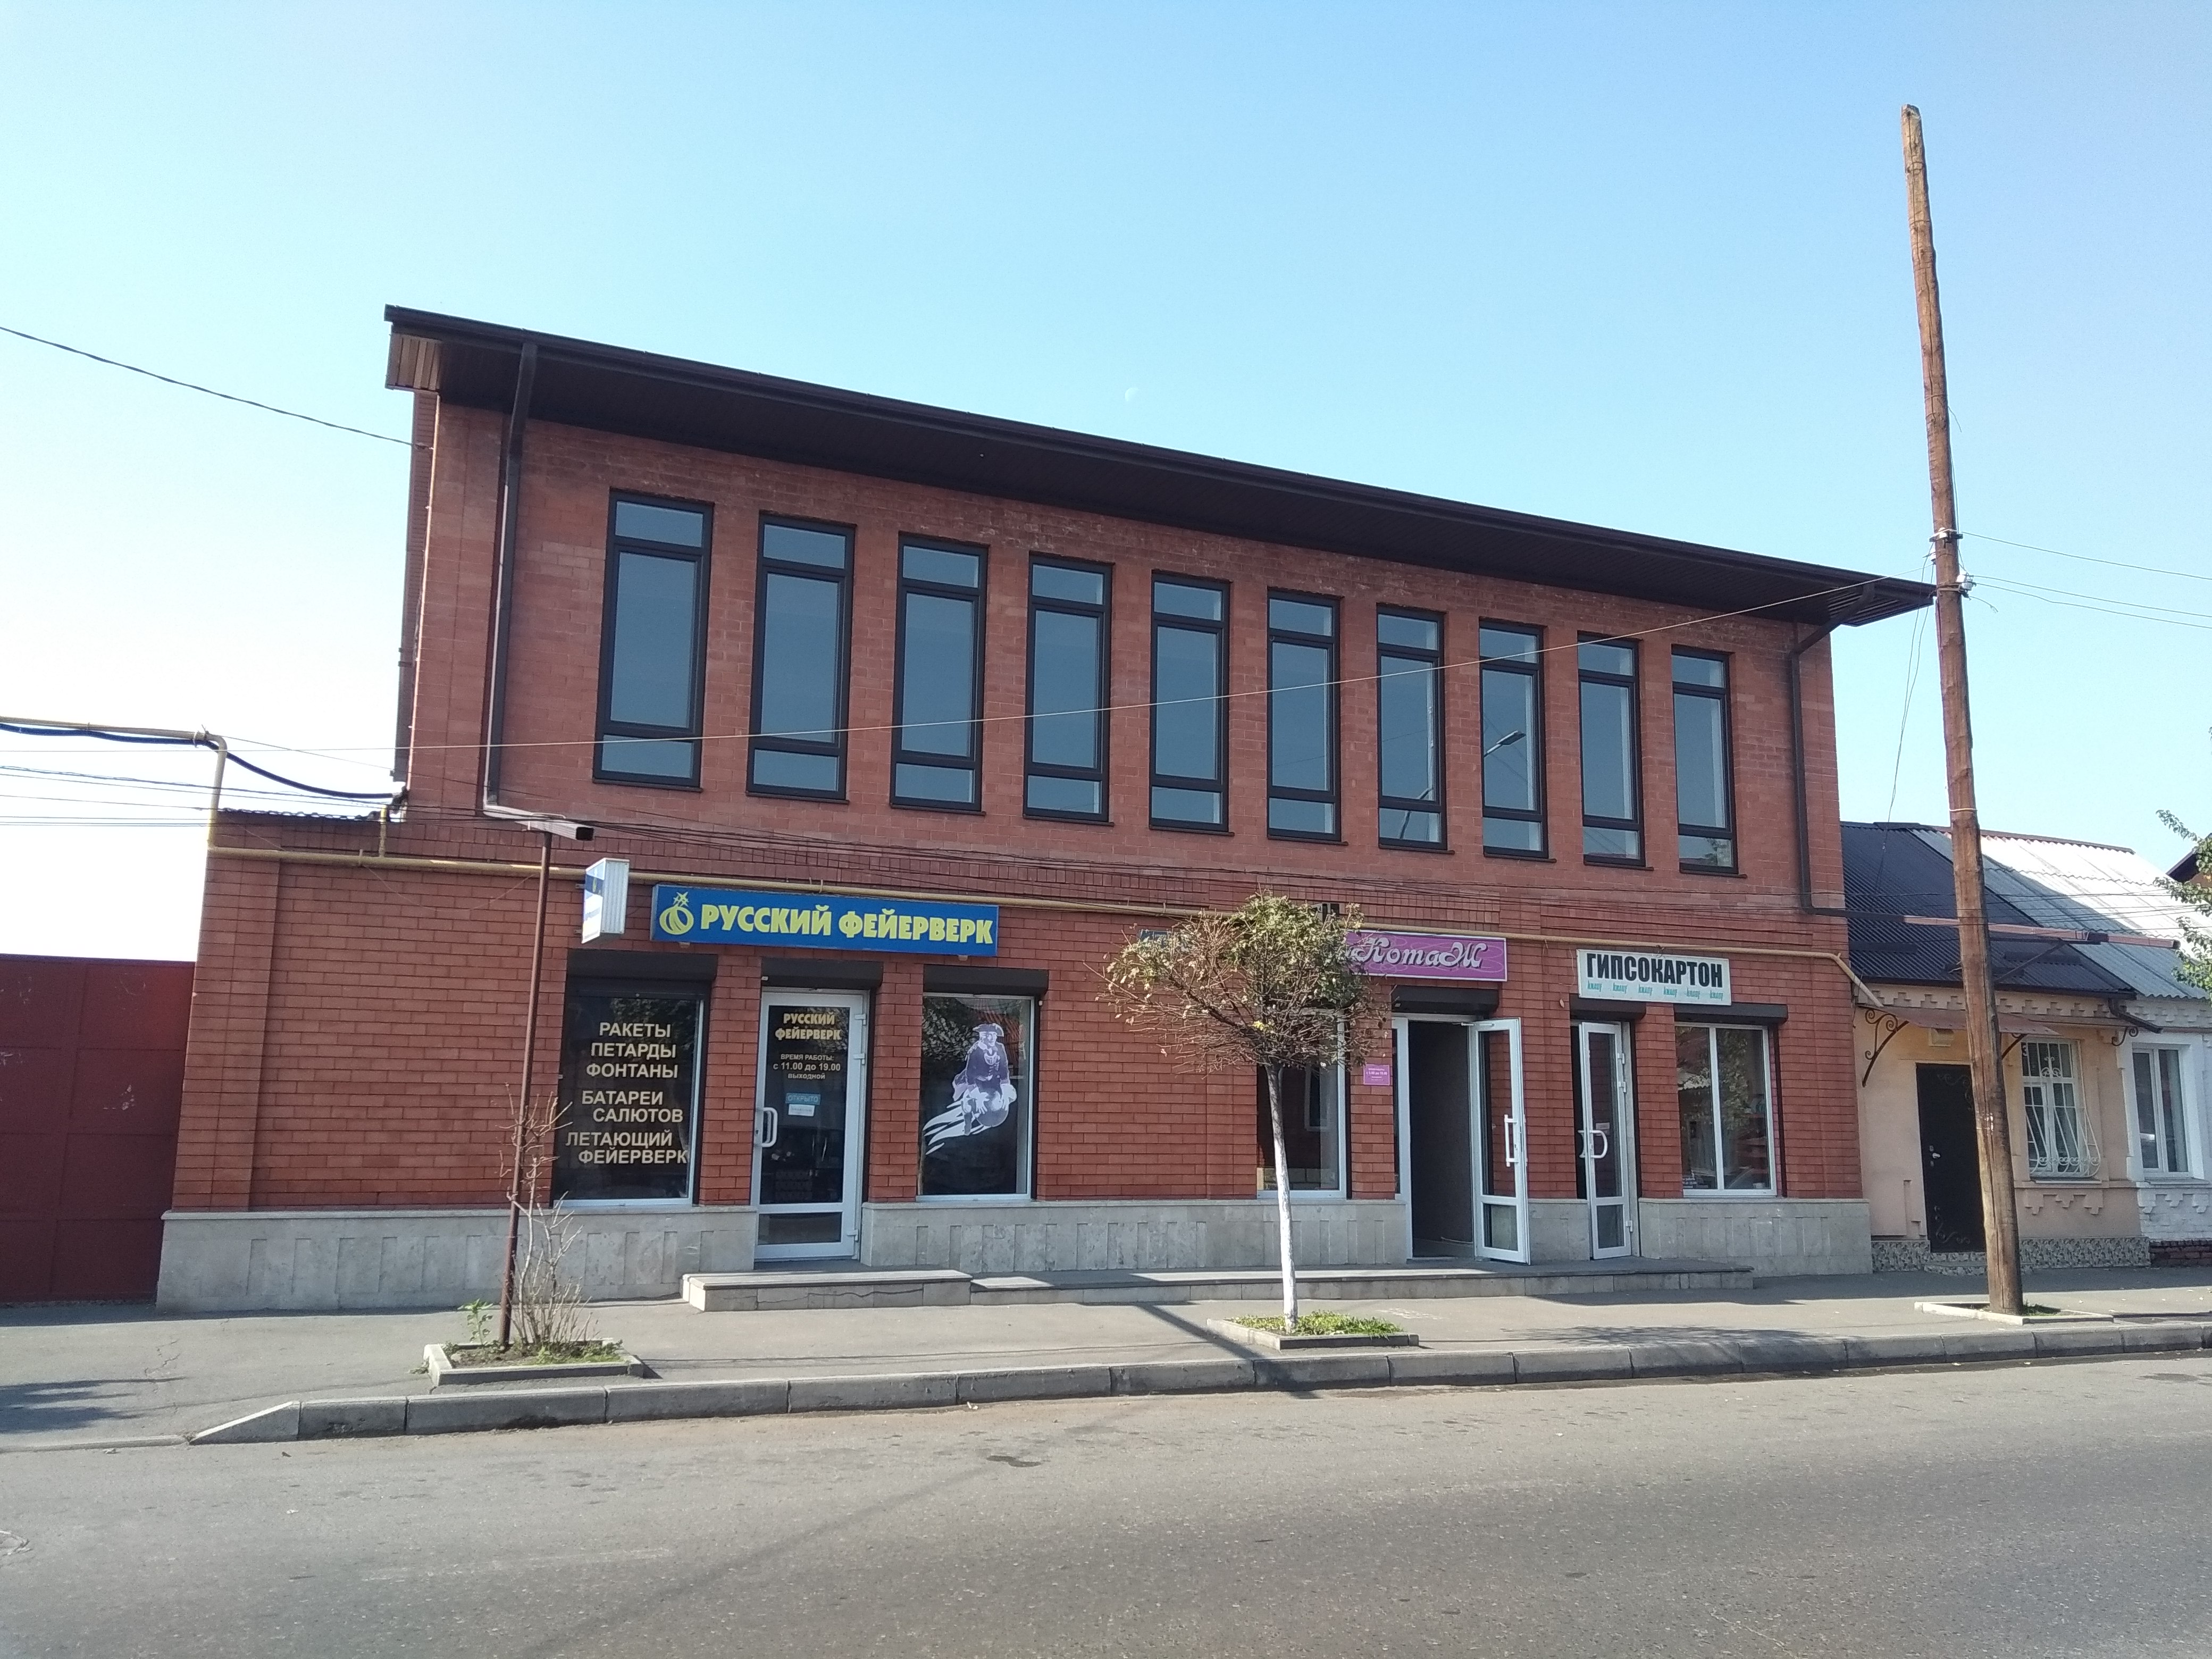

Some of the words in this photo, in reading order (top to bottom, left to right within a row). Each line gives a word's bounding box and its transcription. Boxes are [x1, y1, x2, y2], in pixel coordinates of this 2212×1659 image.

[701, 904, 832, 935] РУССКИЙ
[839, 908, 993, 944] ФЕЙЕРВЕРК
[1587, 953, 1723, 988] ГИПСОКАРТОН
[783, 1012, 835, 1024] РУССКИЙ
[599, 1022, 671, 1037] РАКЕТЫ
[775, 1026, 842, 1040] ФЕЙЕРВЕРК
[591, 1042, 676, 1060] ПЕТАРДЫ
[586, 1063, 678, 1078] ФОНТАНЫ
[582, 1090, 663, 1105] БАТАРЕИ
[593, 1108, 683, 1122] САЛЮТОВ
[566, 1129, 673, 1149] ЛЕТАЮЩИЙ
[579, 1147, 688, 1164] ФЕЙЕРВЕРК
